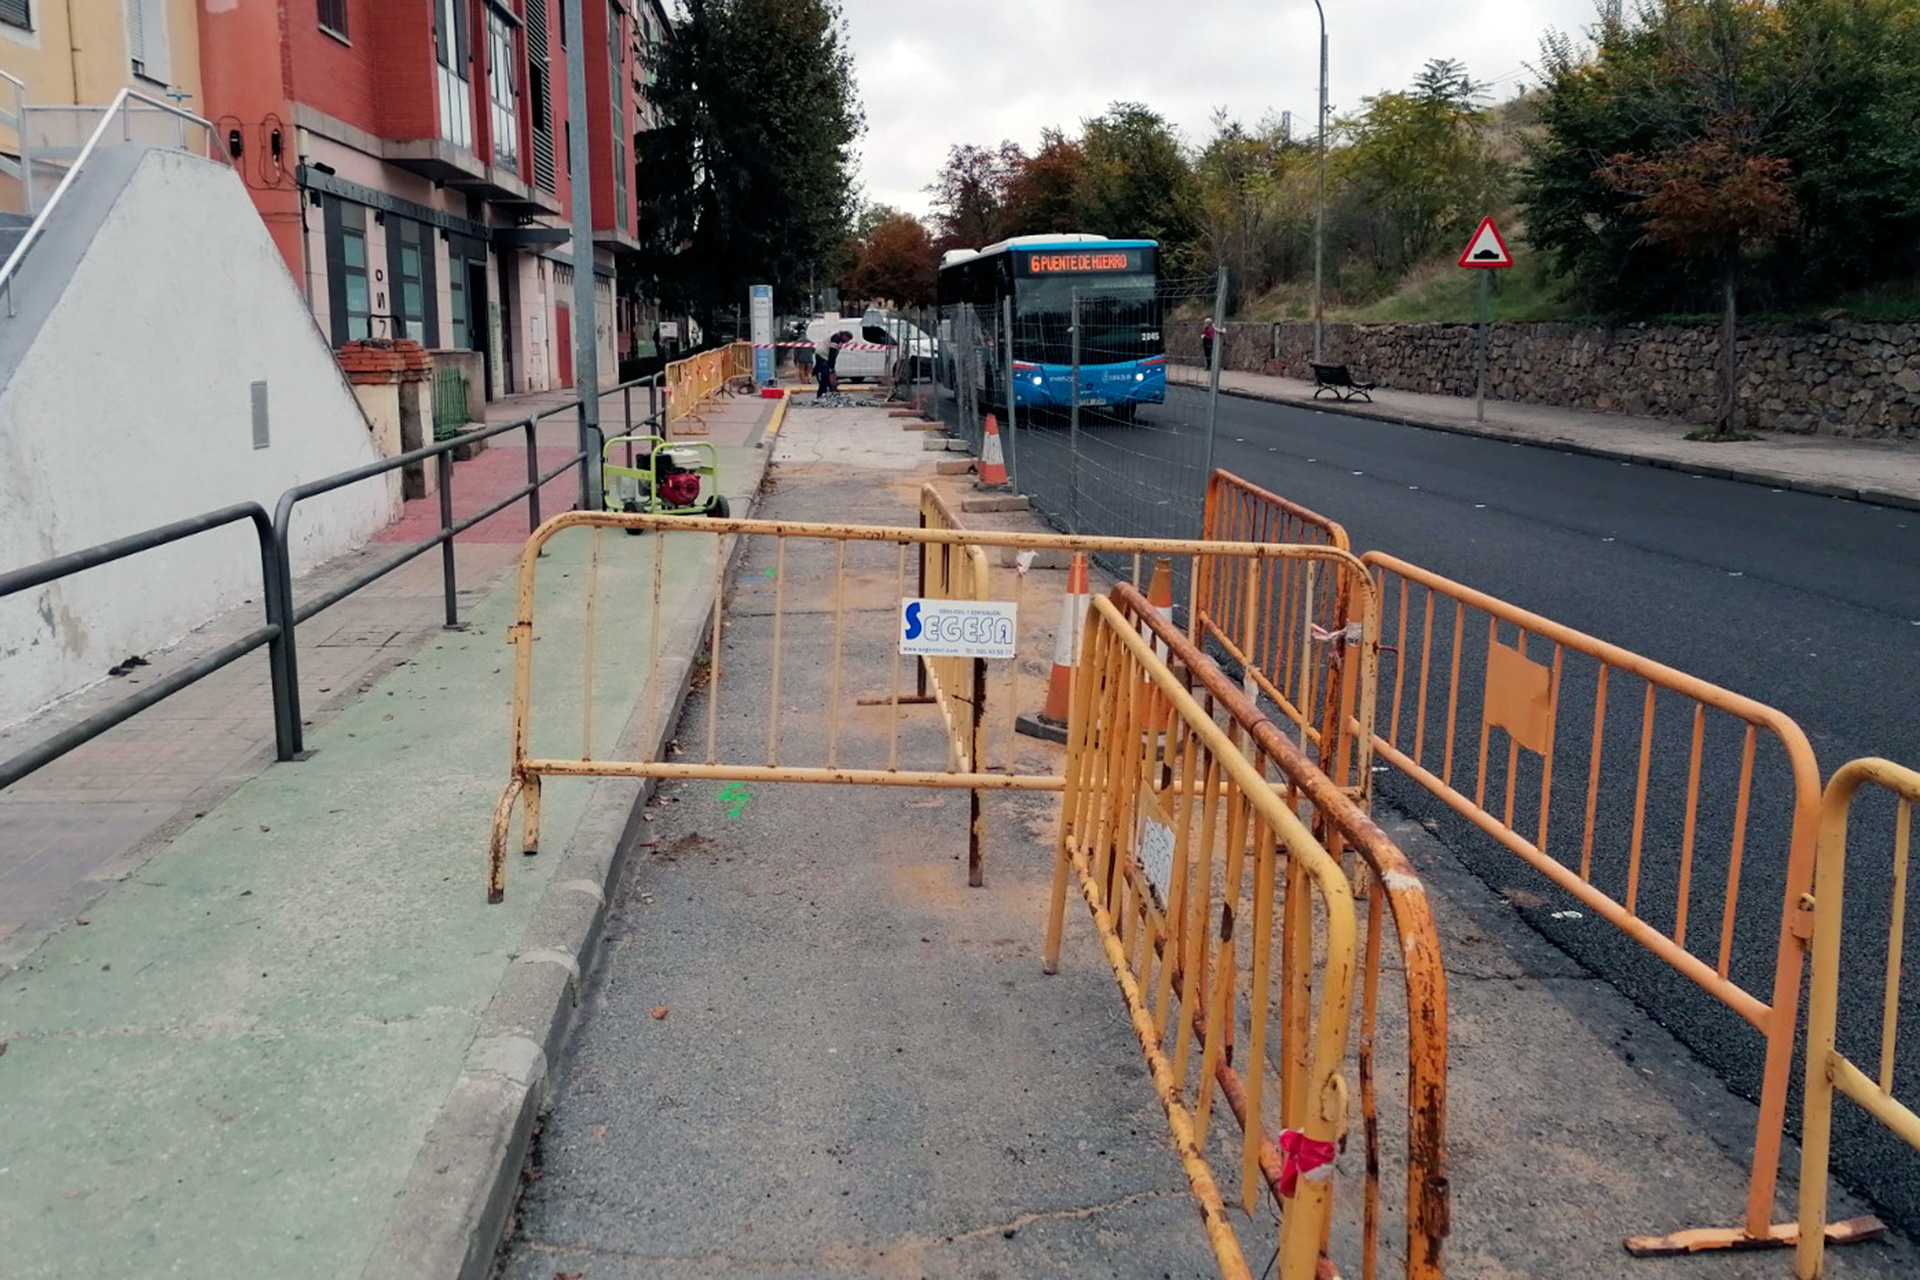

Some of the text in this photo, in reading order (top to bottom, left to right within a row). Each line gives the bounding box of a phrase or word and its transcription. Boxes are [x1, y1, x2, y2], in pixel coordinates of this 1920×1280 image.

[1031, 254, 1127, 272] 6 PUENTE DE HIERRO
[905, 602, 1013, 644] SEGESA
